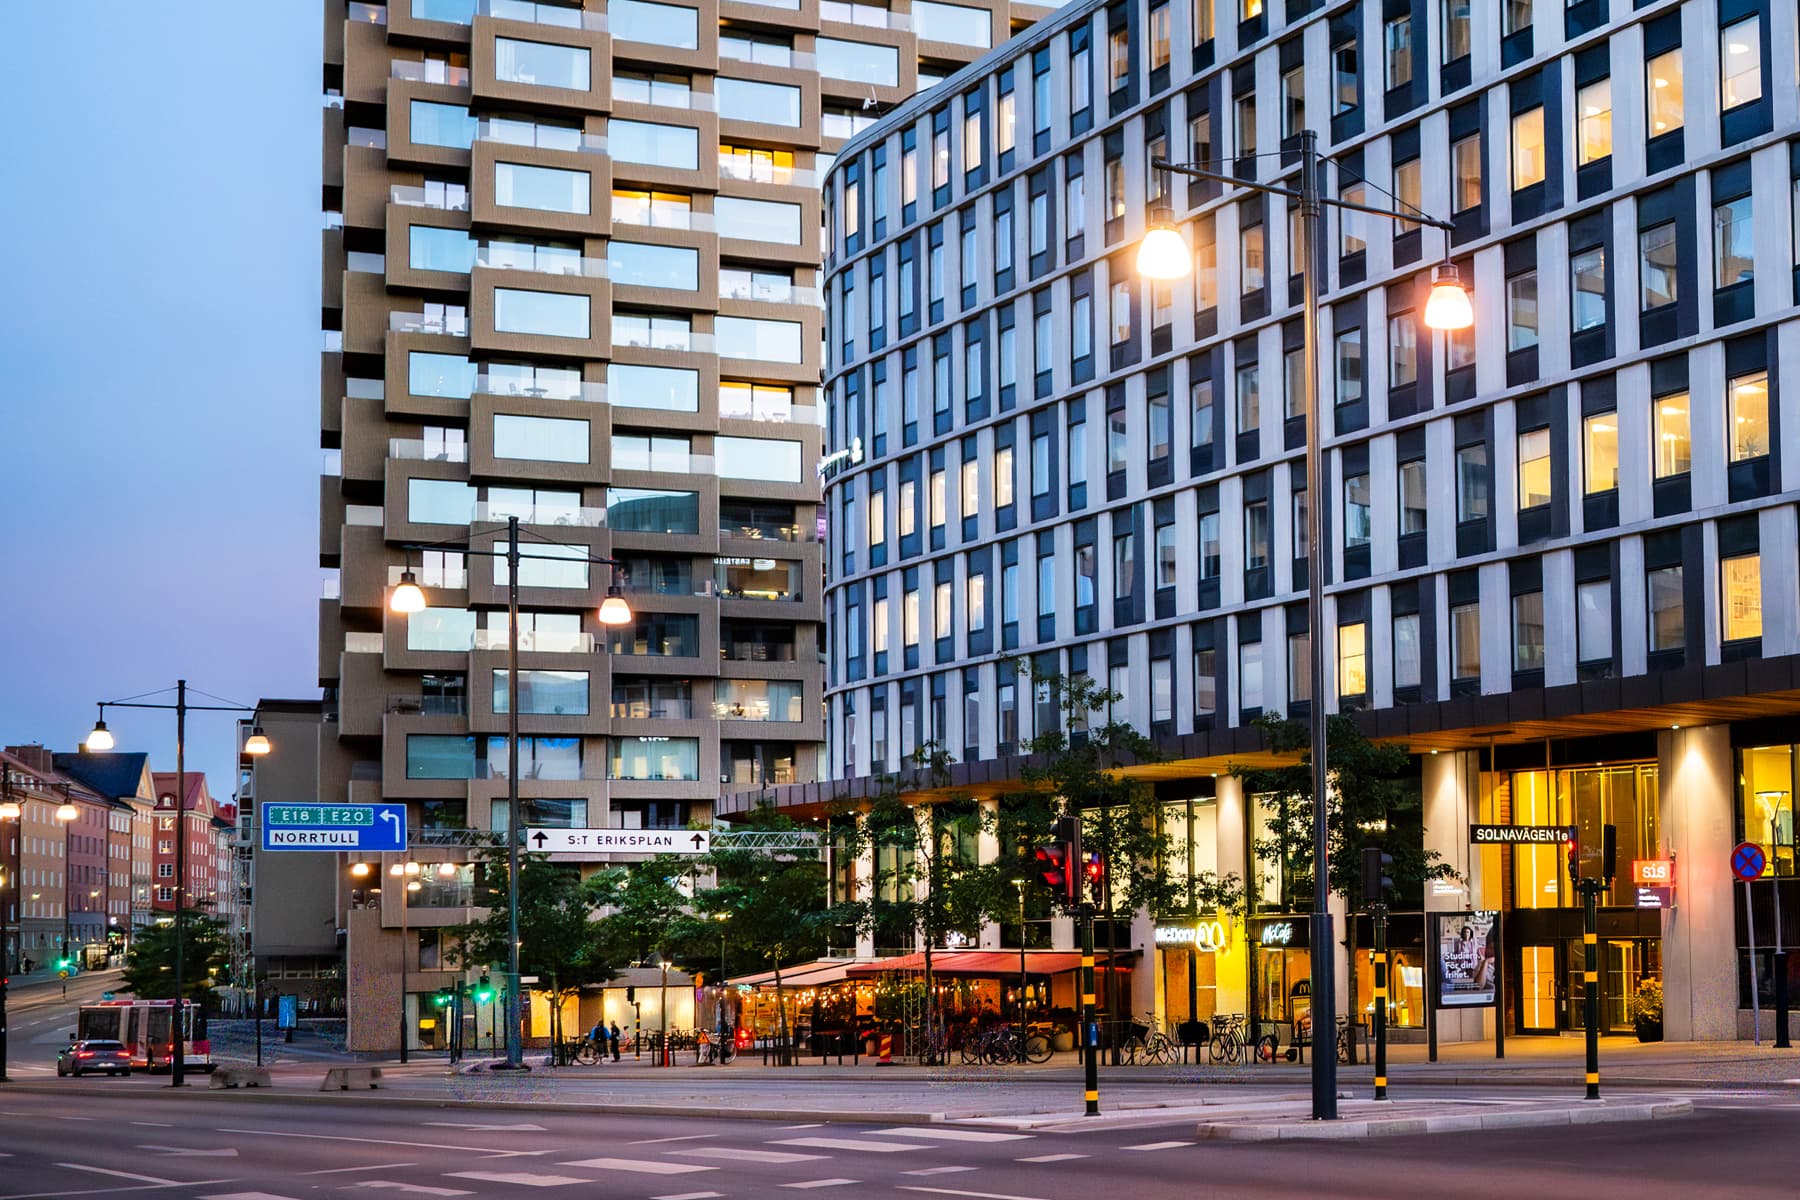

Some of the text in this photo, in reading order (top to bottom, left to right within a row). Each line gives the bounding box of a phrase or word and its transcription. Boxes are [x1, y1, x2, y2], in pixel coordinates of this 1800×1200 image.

[282, 811, 364, 822] E18 E20
[274, 832, 355, 843] NORRTULL
[1476, 827, 1554, 841] SOLNAVÄGEN
[567, 835, 672, 846] S:T ERIKSPLAN
